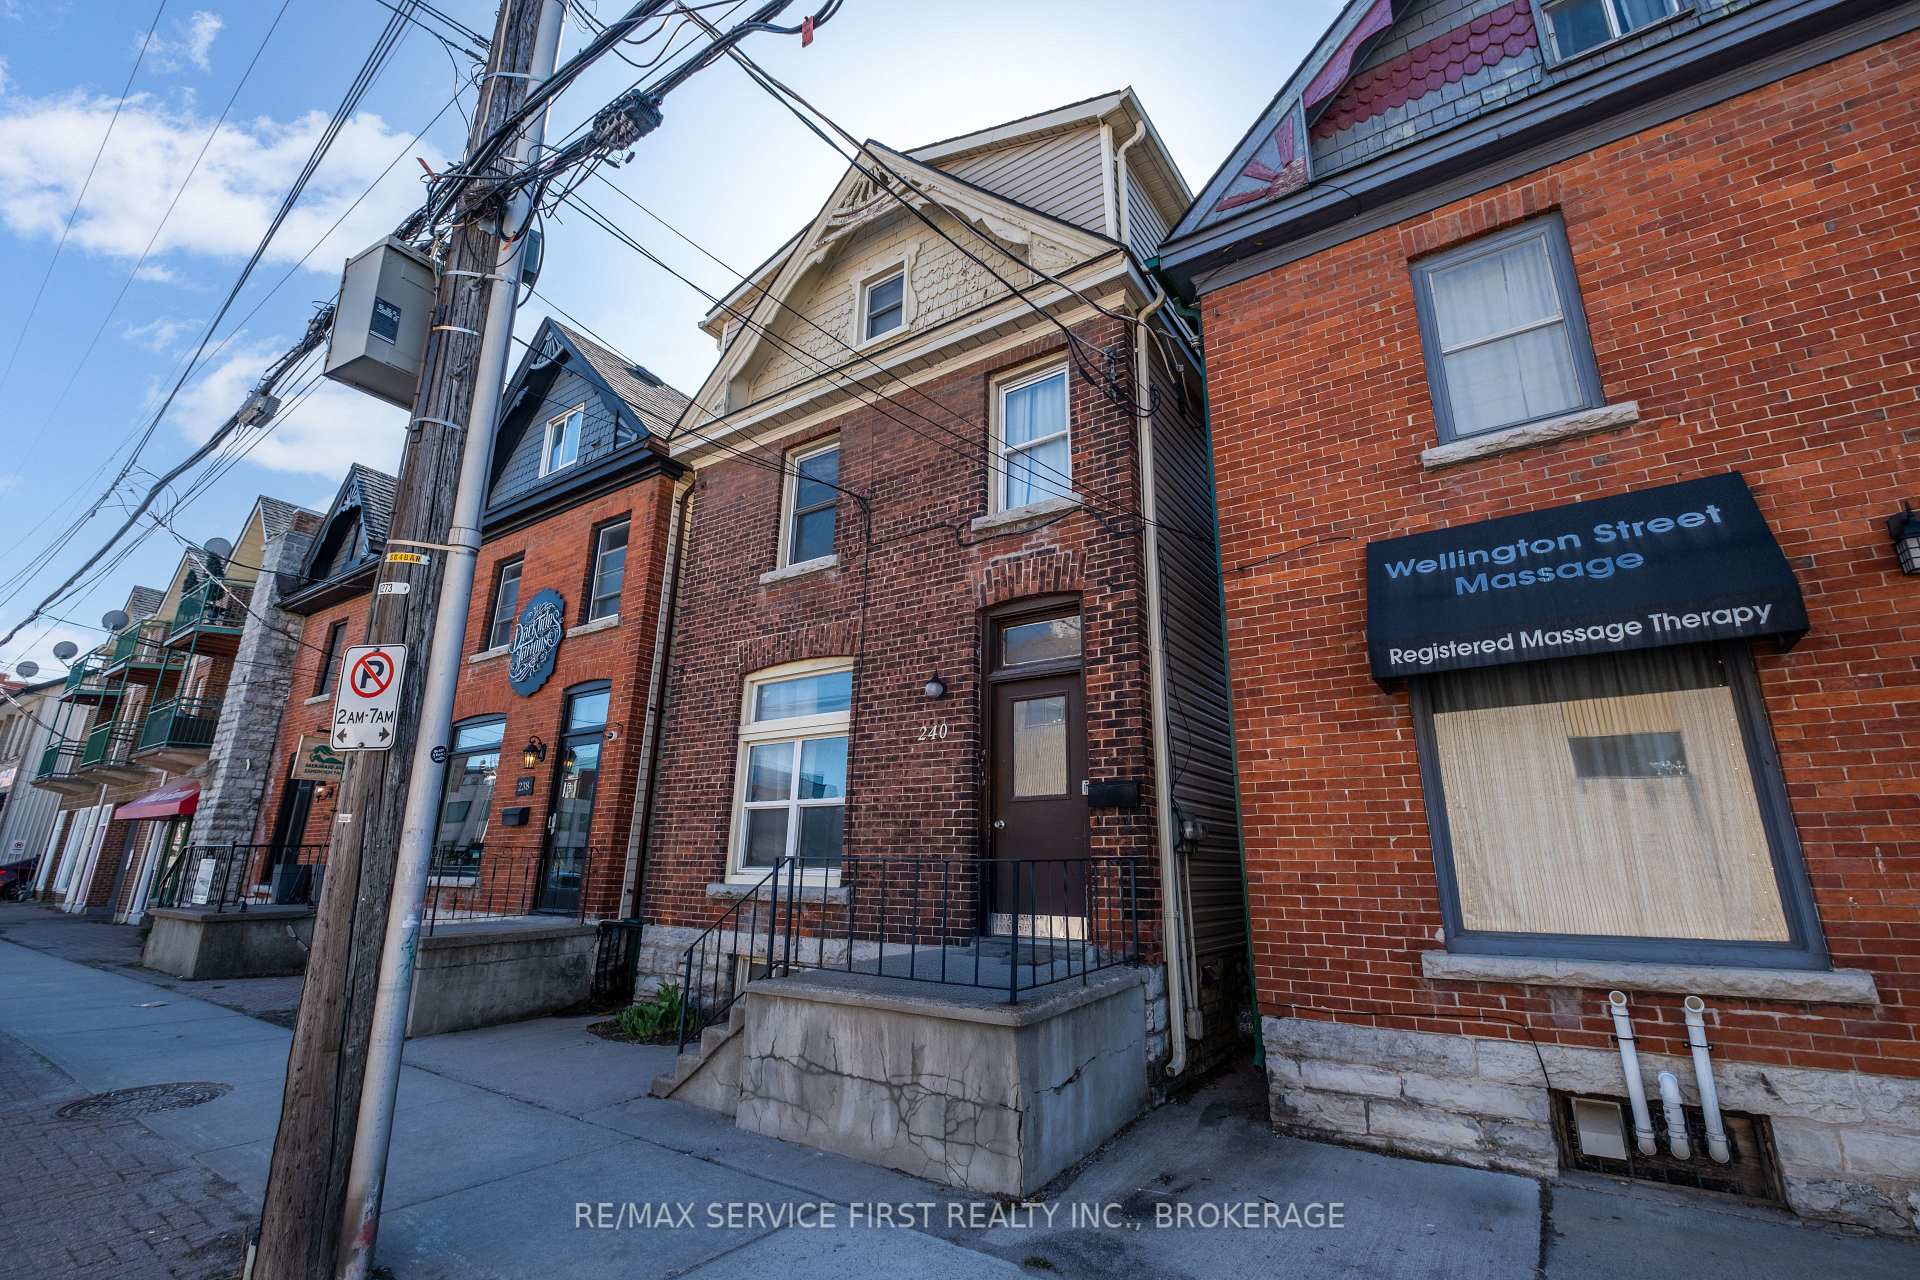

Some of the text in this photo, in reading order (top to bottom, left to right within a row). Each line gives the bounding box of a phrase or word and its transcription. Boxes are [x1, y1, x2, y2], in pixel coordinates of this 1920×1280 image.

[1385, 504, 1722, 579] Wellington Street
[1455, 551, 1644, 596] Massage
[1389, 603, 1773, 666] Registered Massage Therapy
[917, 723, 948, 742] 240
